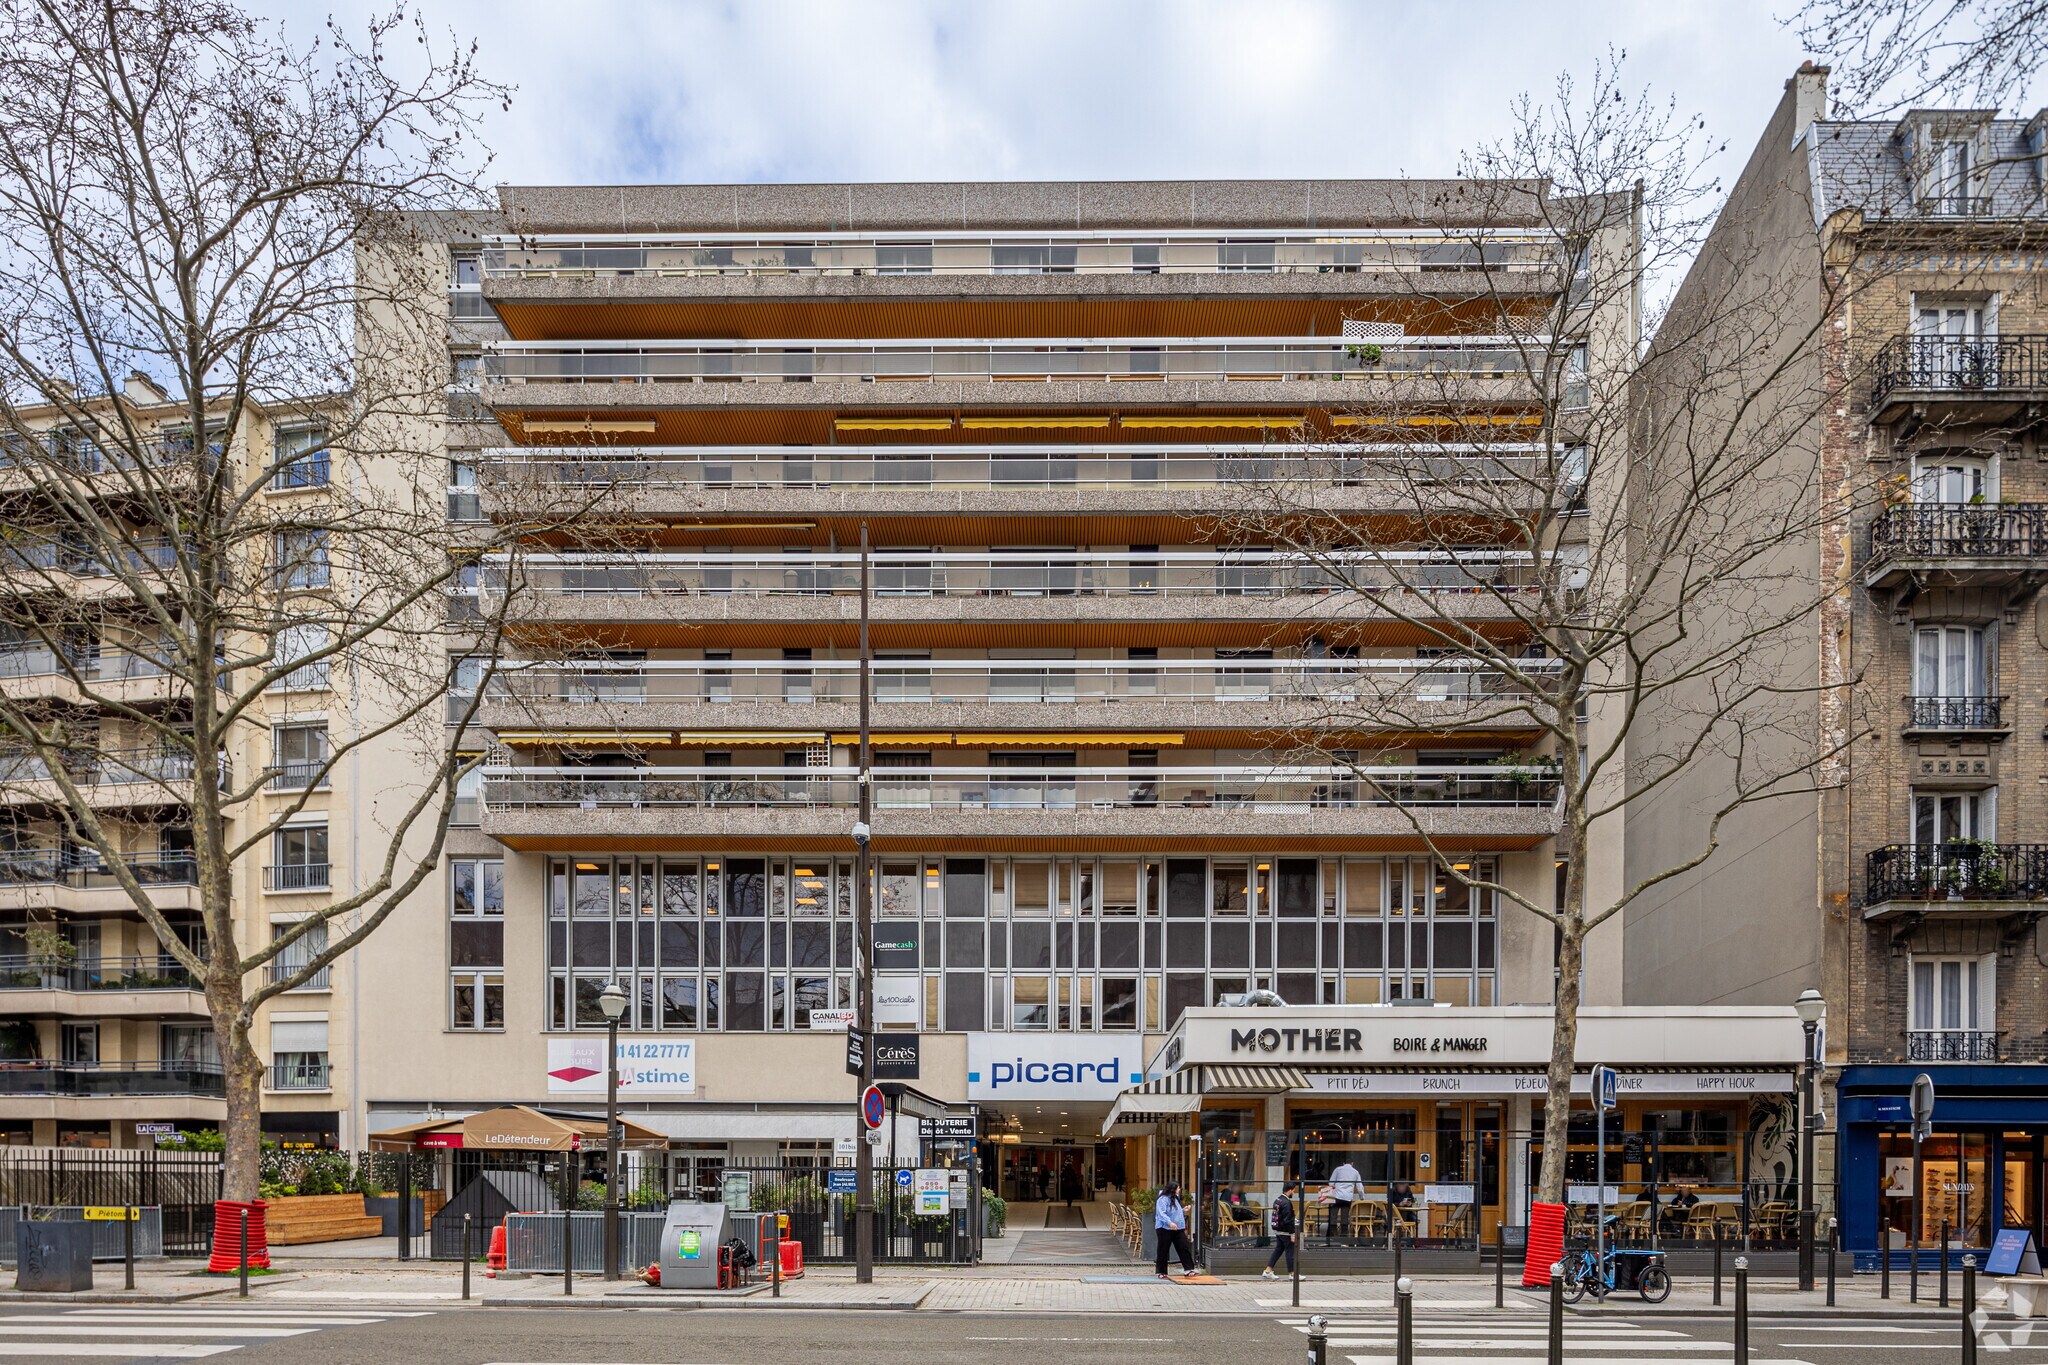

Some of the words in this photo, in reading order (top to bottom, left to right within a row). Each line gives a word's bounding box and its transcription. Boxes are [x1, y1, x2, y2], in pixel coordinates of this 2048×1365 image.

[875, 941, 913, 949] Gamecash
[812, 1012, 840, 1020] CANAL
[1231, 1028, 1363, 1051] MOTHER
[1393, 1038, 1427, 1051] BOIRE
[1431, 1038, 1441, 1052] &
[1443, 1038, 1488, 1051] MANGER
[627, 1045, 641, 1058] 41
[643, 1045, 658, 1058] 22
[660, 1045, 673, 1058] 77
[676, 1045, 690, 1058] 77
[992, 1057, 1119, 1089] picard
[1352, 1076, 1370, 1089] DÉJ
[1422, 1078, 1461, 1090] BRUNCH
[1515, 1077, 1549, 1089] DÉJEUN
[1697, 1077, 1726, 1089] HAPPY
[1729, 1077, 1756, 1088] HOUR
[485, 1134, 551, 1145] LeDétendeur
[1053, 1137, 1076, 1145] picard
[1942, 1182, 1975, 1191] SUNDAYS
